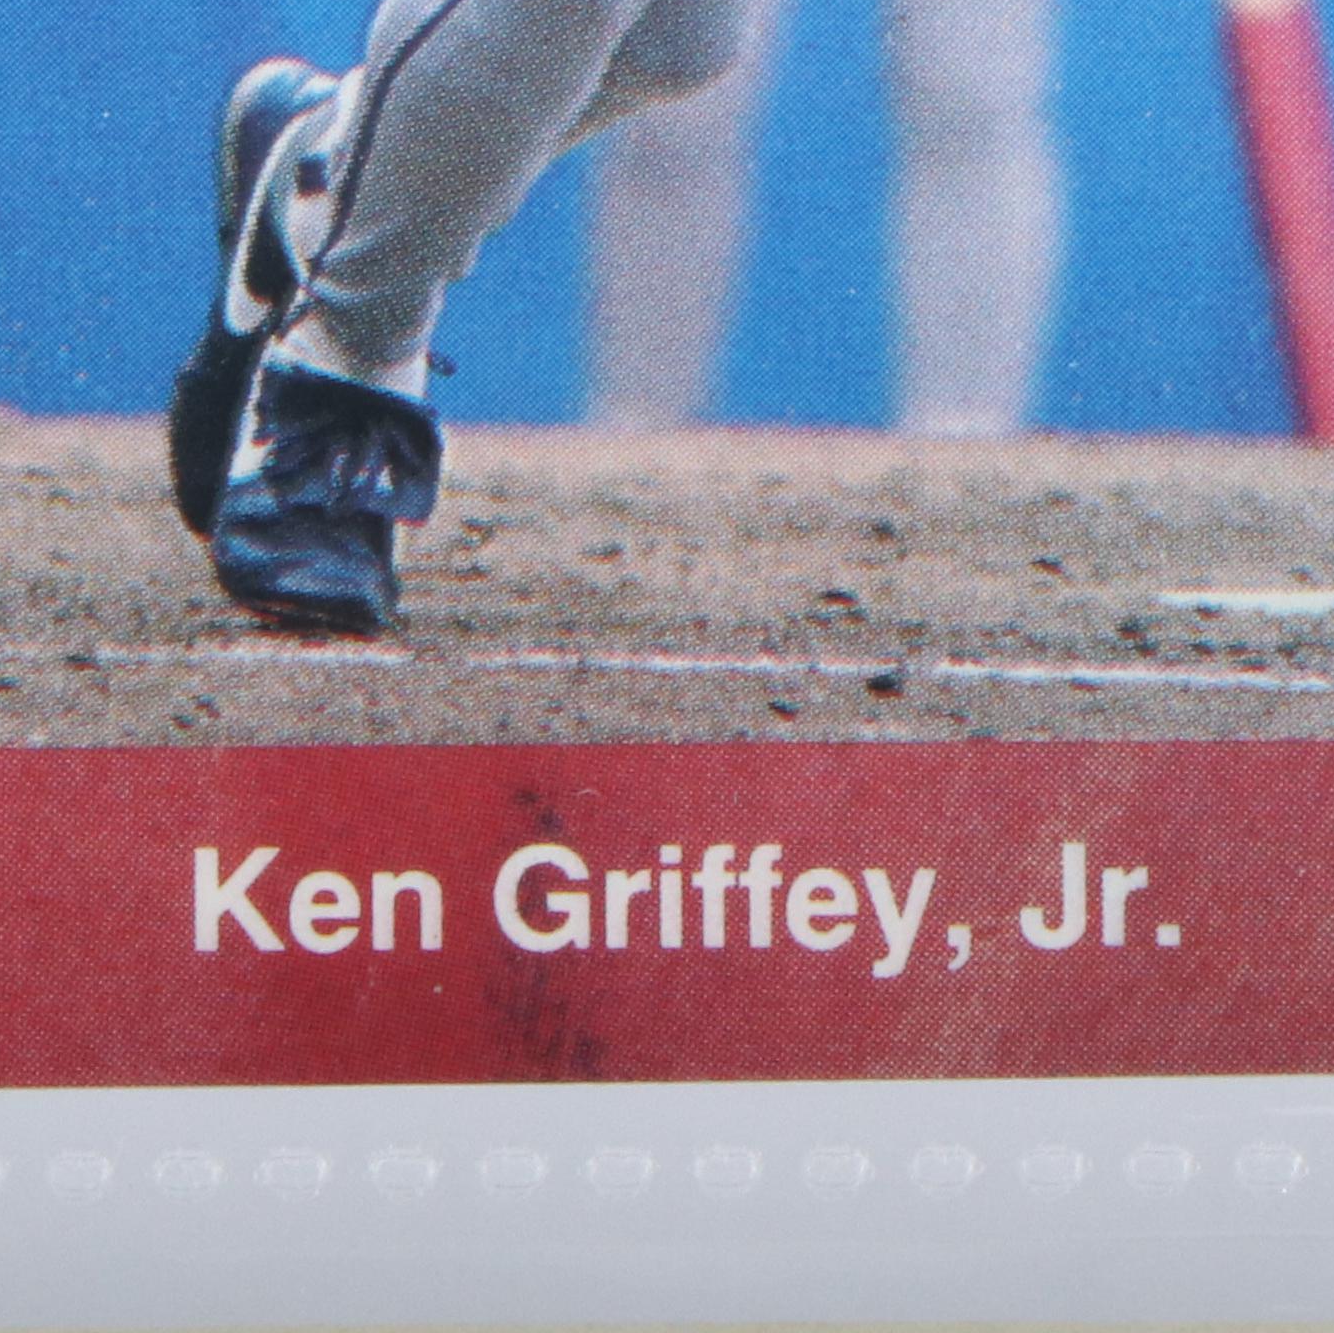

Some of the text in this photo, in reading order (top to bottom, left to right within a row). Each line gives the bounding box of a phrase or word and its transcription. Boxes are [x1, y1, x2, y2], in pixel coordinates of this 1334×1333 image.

[192, 841, 1183, 981] Ken Griffey, Jr.
